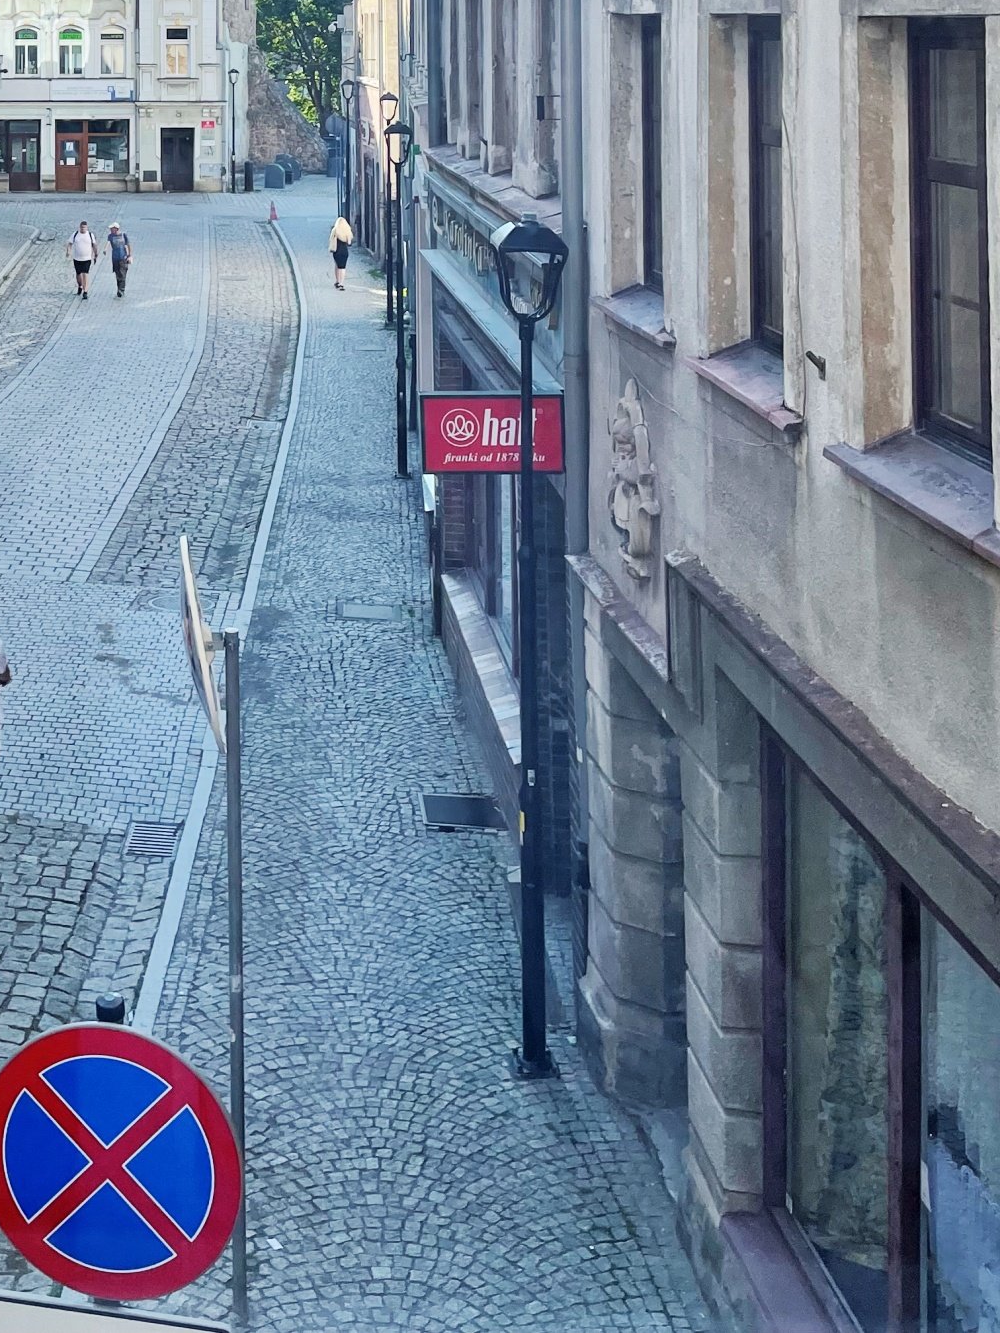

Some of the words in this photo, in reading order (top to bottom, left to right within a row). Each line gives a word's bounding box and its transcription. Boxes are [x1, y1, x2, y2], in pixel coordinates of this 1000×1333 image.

[443, 452, 478, 464] firanki
[480, 452, 493, 463] od
[496, 452, 519, 463] 1878
